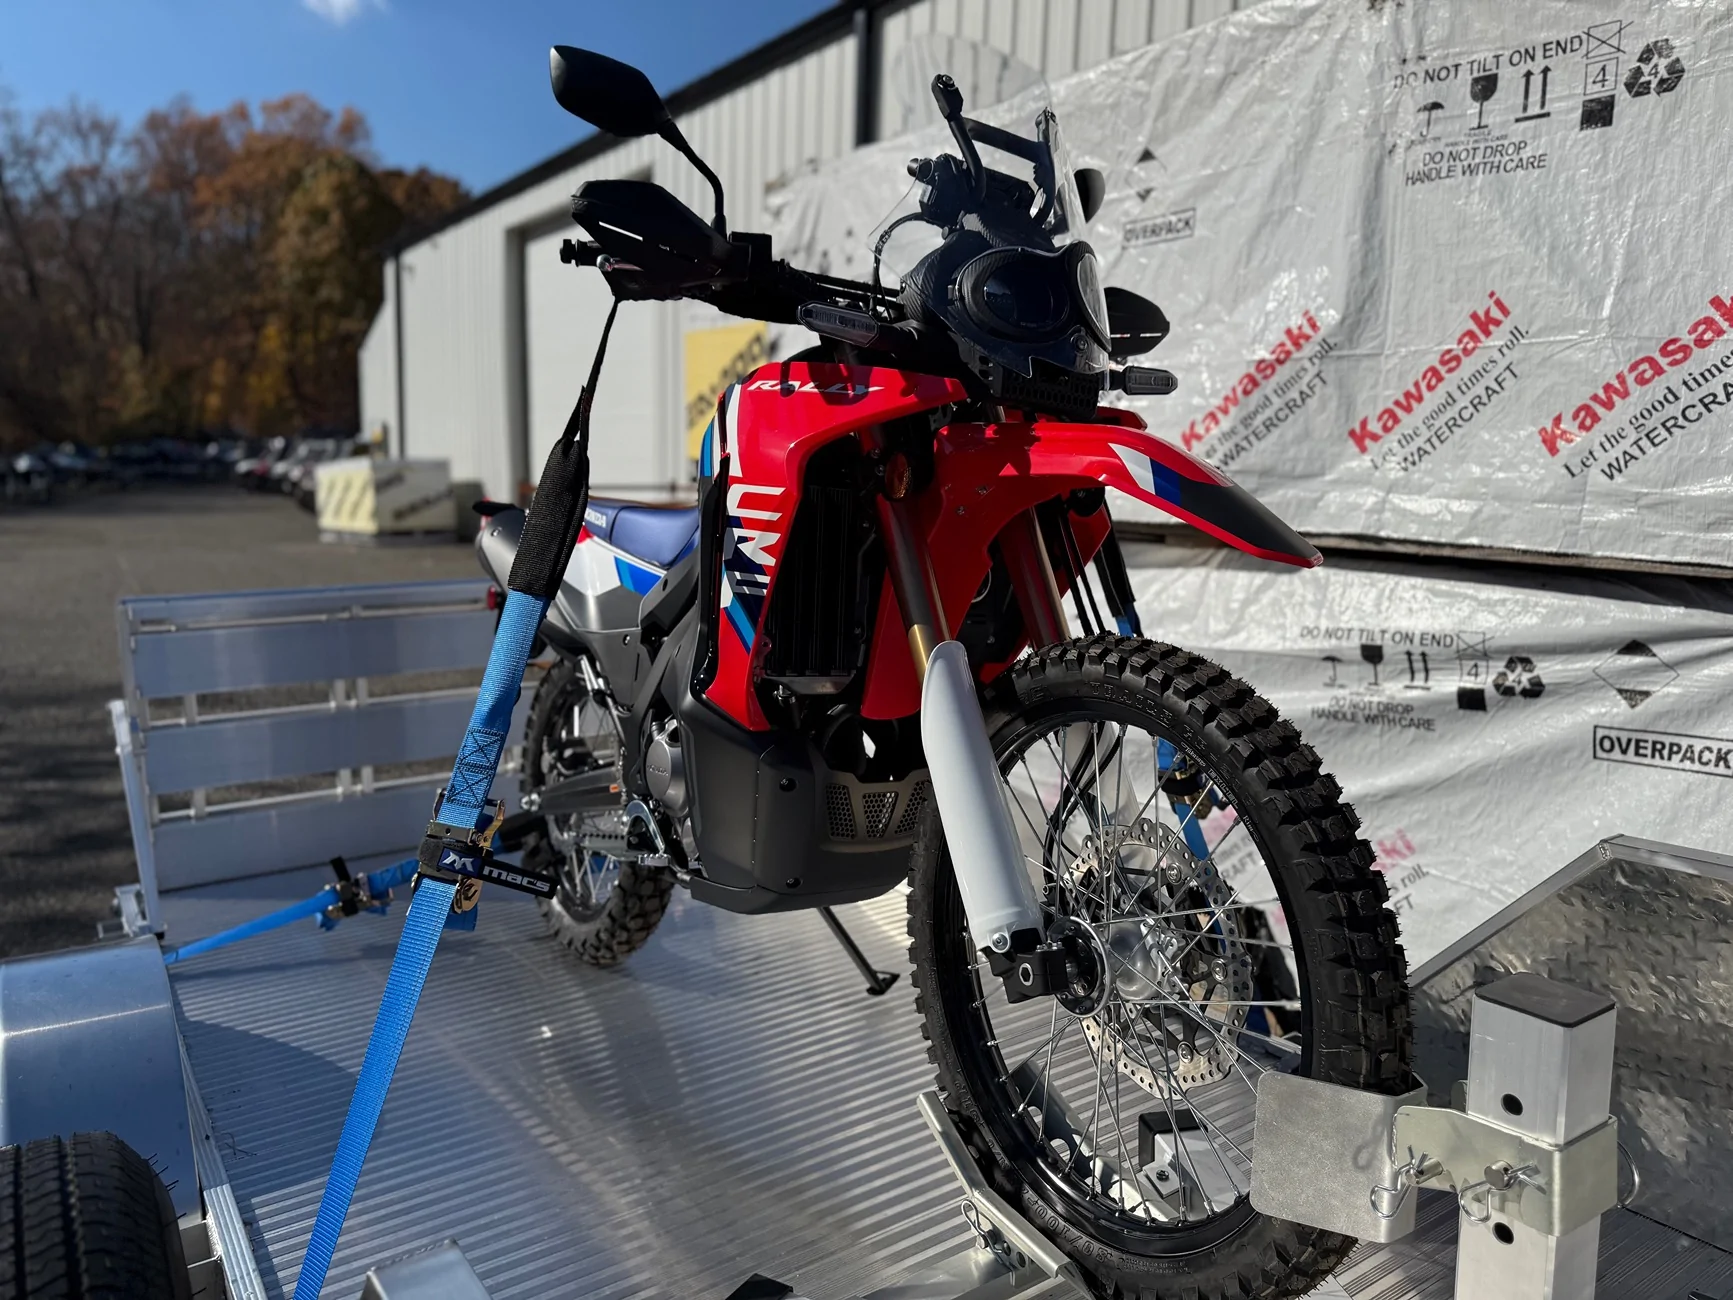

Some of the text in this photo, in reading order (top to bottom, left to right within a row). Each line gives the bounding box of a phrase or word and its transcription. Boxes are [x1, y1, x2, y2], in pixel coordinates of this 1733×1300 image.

[1423, 64, 1462, 84] NOT
[1467, 54, 1503, 76] TILT
[1509, 46, 1536, 66] ON
[1542, 35, 1583, 60] END
[1592, 64, 1608, 88] 4
[1405, 153, 1548, 187] HANDLE WITH CARE
[1422, 140, 1528, 167] DO NOT DROP
[747, 380, 886, 395] RALLY
[1180, 309, 1321, 452] Kawasaki
[1217, 425, 1239, 447] the
[1240, 395, 1273, 430] good
[1273, 366, 1309, 399] times
[1308, 337, 1338, 367] roll.
[1347, 290, 1511, 455] Kawasaki
[1396, 425, 1423, 451] the
[1421, 392, 1458, 432] good
[1456, 359, 1499, 396] times
[1497, 324, 1530, 360] roll.
[1538, 294, 1733, 457] Kawasak
[1218, 369, 1328, 467] WATERCRAFT
[1397, 361, 1524, 473] WATERCRAFT
[1562, 349, 1733, 479] Let the good time
[1600, 381, 1733, 481] WATERCRA
[1300, 625, 1454, 649] DO NOT TILT ON END
[1467, 662, 1479, 680] 4
[1311, 706, 1437, 731] HANDLE WITH CARE
[1328, 696, 1414, 714] DO NOT DROP
[1598, 734, 1733, 770] OVERPACK
[1207, 768, 1239, 809] EXCEL
